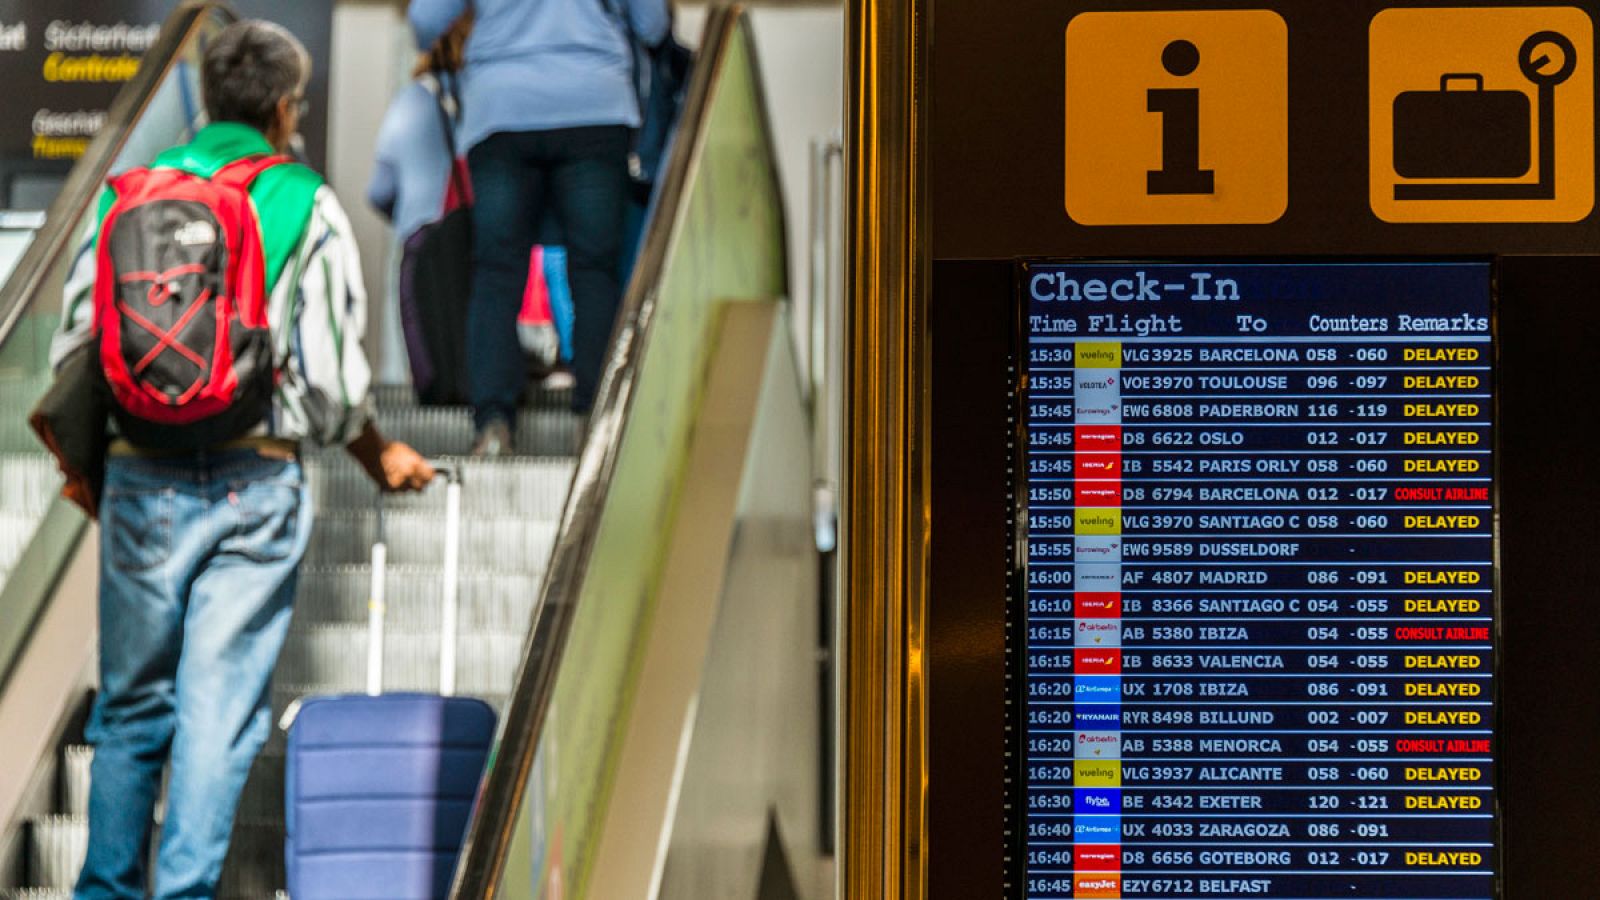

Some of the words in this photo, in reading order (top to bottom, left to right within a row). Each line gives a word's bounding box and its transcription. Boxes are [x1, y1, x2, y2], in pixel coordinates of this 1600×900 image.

[1030, 272, 1240, 301] Check-In
[1029, 314, 1077, 332] Time
[1088, 314, 1183, 336] Flight
[1236, 315, 1268, 332] To
[1309, 314, 1389, 332] Counters
[1398, 313, 1489, 332] Remarks
[1030, 348, 1073, 362] 15:30
[1080, 349, 1114, 361] vueling
[1151, 348, 1193, 362] 3925
[1199, 348, 1300, 362] BARCELONA
[1305, 347, 1337, 362] 058
[1403, 348, 1479, 361] DELAYED
[1029, 376, 1073, 390] 15:35
[1151, 375, 1193, 389] 3970
[1197, 375, 1288, 389] TOULOUSE
[1306, 375, 1339, 389] 096
[1403, 375, 1480, 389] DELAYED
[1030, 404, 1072, 418] 15:45
[1151, 404, 1193, 417] 6808
[1199, 403, 1299, 417] PADERBORN
[1308, 403, 1339, 417] 116
[1403, 403, 1480, 417] DELAYED
[1029, 432, 1072, 445] 15:45
[1123, 431, 1145, 445] D8
[1152, 431, 1194, 445] 6622
[1199, 431, 1244, 445] OSLO
[1307, 431, 1339, 445] 012
[1403, 431, 1480, 445] DELAYED
[1029, 459, 1072, 473] 15:45
[1123, 459, 1142, 473] IB
[1152, 459, 1193, 473] 5542
[1199, 459, 1252, 473] PARIS
[1255, 459, 1301, 473] ORLY
[1307, 459, 1339, 473] 058
[1403, 459, 1480, 473] DELAYED
[1029, 487, 1072, 501] 15:50
[1123, 487, 1145, 501] D8
[1151, 487, 1193, 501] 6794
[1199, 487, 1300, 501] BARCELONA
[1307, 487, 1339, 501] 012
[1394, 487, 1443, 501] CONSULT
[1445, 487, 1490, 501] AIRLINE
[1029, 515, 1072, 529] 15:50
[1080, 516, 1114, 528] vueling
[1151, 515, 1193, 529] 3970
[1199, 515, 1285, 529] SANTIAGO
[1288, 515, 1300, 529] C
[1307, 515, 1339, 529] 058
[1404, 515, 1480, 529] DELAYED
[1029, 543, 1072, 557] 15:55
[1151, 543, 1193, 556] 9589
[1199, 542, 1300, 557] DUSSELDORF
[1029, 571, 1072, 585] 16:00
[1122, 571, 1144, 584] AF
[1151, 571, 1194, 584] 4807
[1199, 571, 1268, 584] MADRID
[1307, 570, 1339, 584] 086
[1404, 571, 1481, 584] DELAYED
[1029, 598, 1072, 613] 16:10
[1122, 599, 1142, 613] IB
[1151, 599, 1194, 613] 8366
[1199, 598, 1285, 613] SANTIAGO
[1288, 598, 1300, 613] C
[1307, 599, 1340, 613] 054
[1404, 599, 1481, 613] DELAYED
[1029, 627, 1072, 640] 16:15
[1121, 627, 1145, 640] AB
[1152, 626, 1194, 640] 5380
[1199, 627, 1249, 641] IBIZA
[1307, 626, 1339, 641] 054
[1394, 626, 1444, 641] CONSULT
[1445, 627, 1490, 641] AIRLINE
[1029, 654, 1072, 668] 16:15
[1122, 655, 1142, 668] IB
[1151, 654, 1194, 668] 8633
[1198, 654, 1285, 669] VALENCIA
[1307, 655, 1340, 669] 054
[1404, 655, 1481, 669] DELAYED
[1029, 682, 1072, 696] 16:20
[1122, 682, 1145, 696] UX
[1153, 682, 1194, 696] 1708
[1199, 682, 1249, 696] IBIZA
[1307, 682, 1340, 697] 086
[1404, 683, 1481, 697] DELAYED
[1029, 710, 1072, 724] 16:20
[1082, 713, 1119, 721] RYANAIR
[1151, 711, 1194, 724] 8498
[1199, 711, 1275, 725] BILLUND
[1307, 711, 1340, 725] 002
[1404, 711, 1481, 725] DELAYED
[1029, 738, 1072, 752] 16:20
[1121, 739, 1145, 752] AB
[1152, 738, 1194, 752] 5388
[1199, 739, 1282, 753] MENORCA
[1307, 739, 1340, 753] 054
[1395, 739, 1444, 753] CONSULT
[1446, 739, 1492, 753] AIRLINE
[1029, 766, 1072, 780] 16:20
[1079, 768, 1114, 779] vueling
[1151, 766, 1194, 780] 3937
[1198, 766, 1283, 781] ALICANTE
[1307, 766, 1340, 781] 058
[1404, 767, 1482, 781] DELAYED
[1028, 794, 1072, 808] 16:30
[1122, 795, 1144, 809] BE
[1151, 795, 1194, 809] 4342
[1199, 795, 1263, 809] EXETER
[1308, 795, 1340, 809] 120
[1405, 795, 1482, 809] DELAYED
[1028, 823, 1072, 837] 16:40
[1122, 823, 1145, 837] UX
[1151, 823, 1194, 837] 4033
[1199, 823, 1291, 837] ZARAGOZA
[1307, 823, 1340, 837] 086
[1028, 851, 1072, 865] 16:40
[1122, 851, 1145, 865] D8
[1151, 851, 1194, 865] 6656
[1199, 851, 1292, 865] GOTEBORG
[1307, 851, 1340, 865] 012
[1405, 851, 1482, 866] DELAYED
[1028, 879, 1071, 893] 16:45
[1079, 880, 1116, 890] easyJet
[1151, 879, 1194, 893] 6712
[1199, 879, 1272, 893] BELFAST
